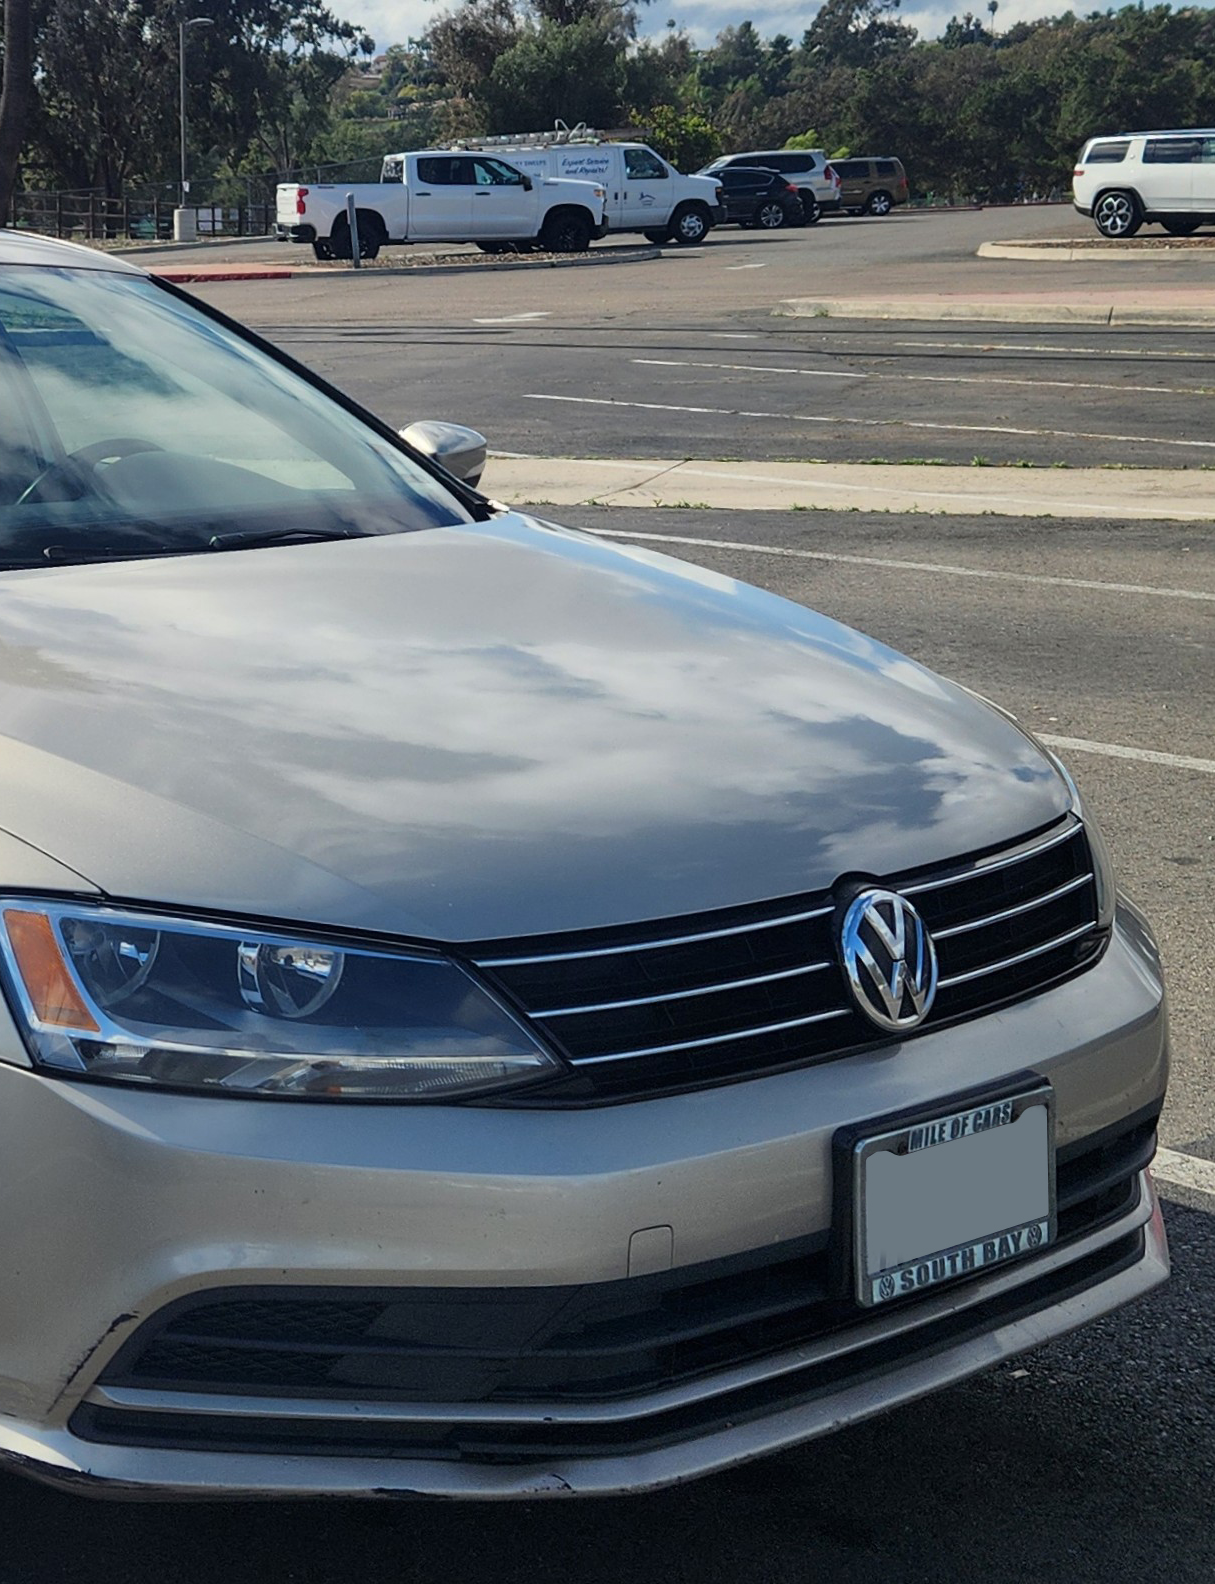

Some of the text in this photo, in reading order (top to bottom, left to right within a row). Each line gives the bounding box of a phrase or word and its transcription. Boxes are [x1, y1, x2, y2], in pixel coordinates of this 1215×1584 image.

[561, 158, 585, 168] Expert
[565, 166, 579, 174] and
[909, 1101, 1012, 1151] MILE OF CARS
[900, 1247, 975, 1291] SOUTH
[982, 1231, 1023, 1265] BAY
